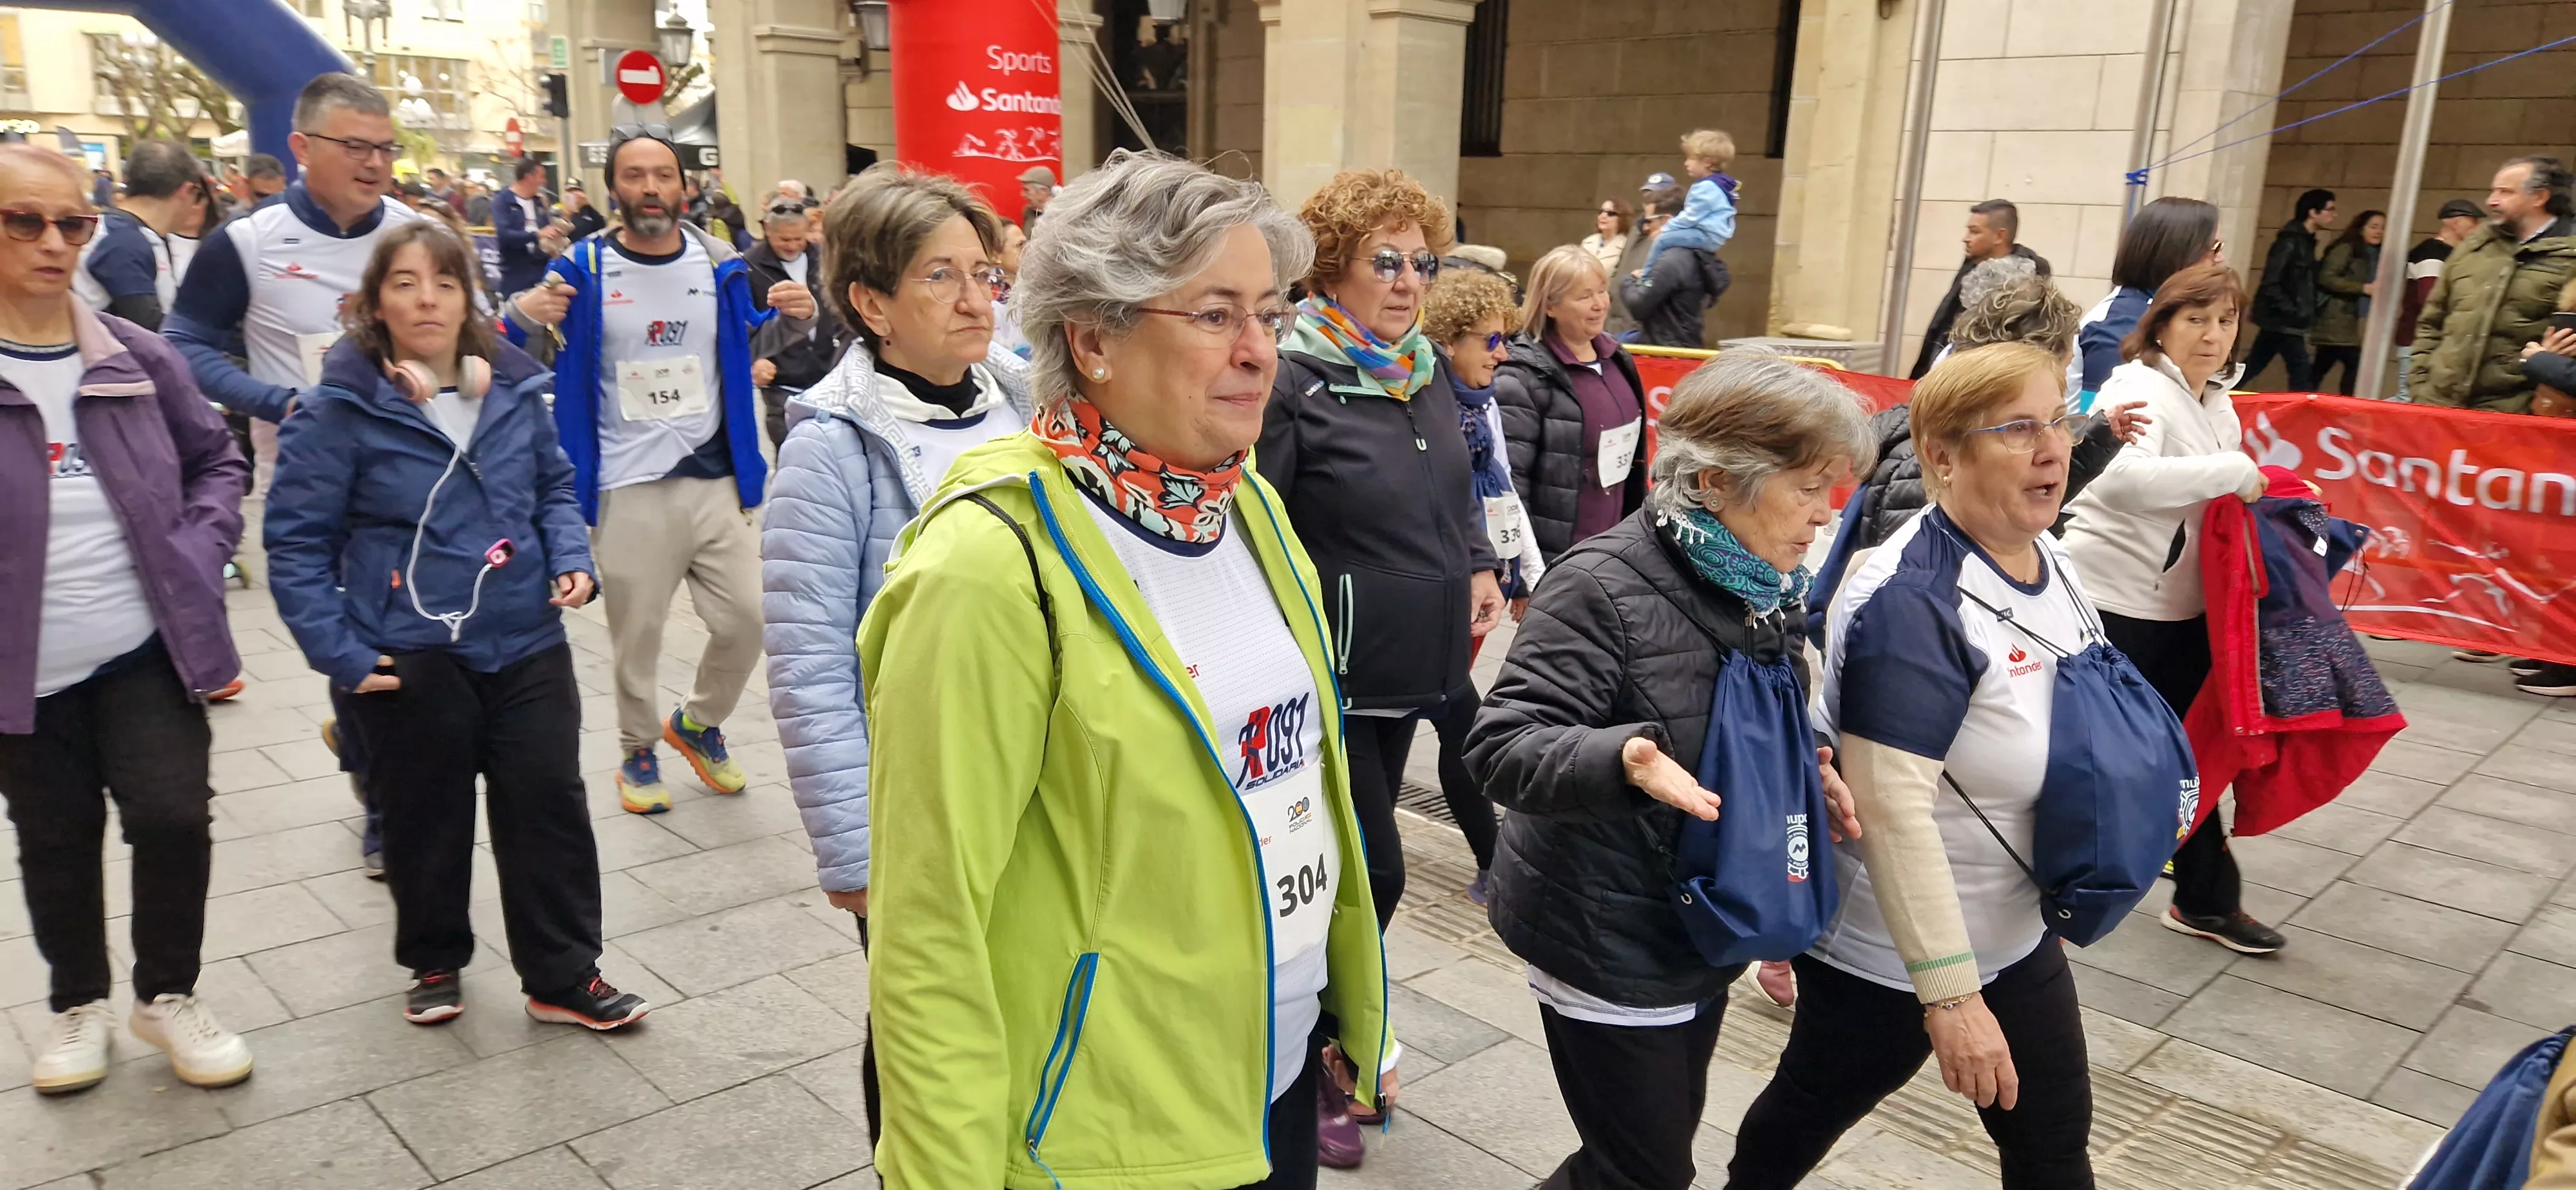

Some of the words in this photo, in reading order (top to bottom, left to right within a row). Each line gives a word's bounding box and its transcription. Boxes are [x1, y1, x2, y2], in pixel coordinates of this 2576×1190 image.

[987, 44, 1052, 75] Sports
[648, 388, 681, 405] 154
[1617, 451, 1632, 469] 33
[1244, 758, 1305, 791] SOLIDARIA
[1276, 852, 1327, 918] 304
